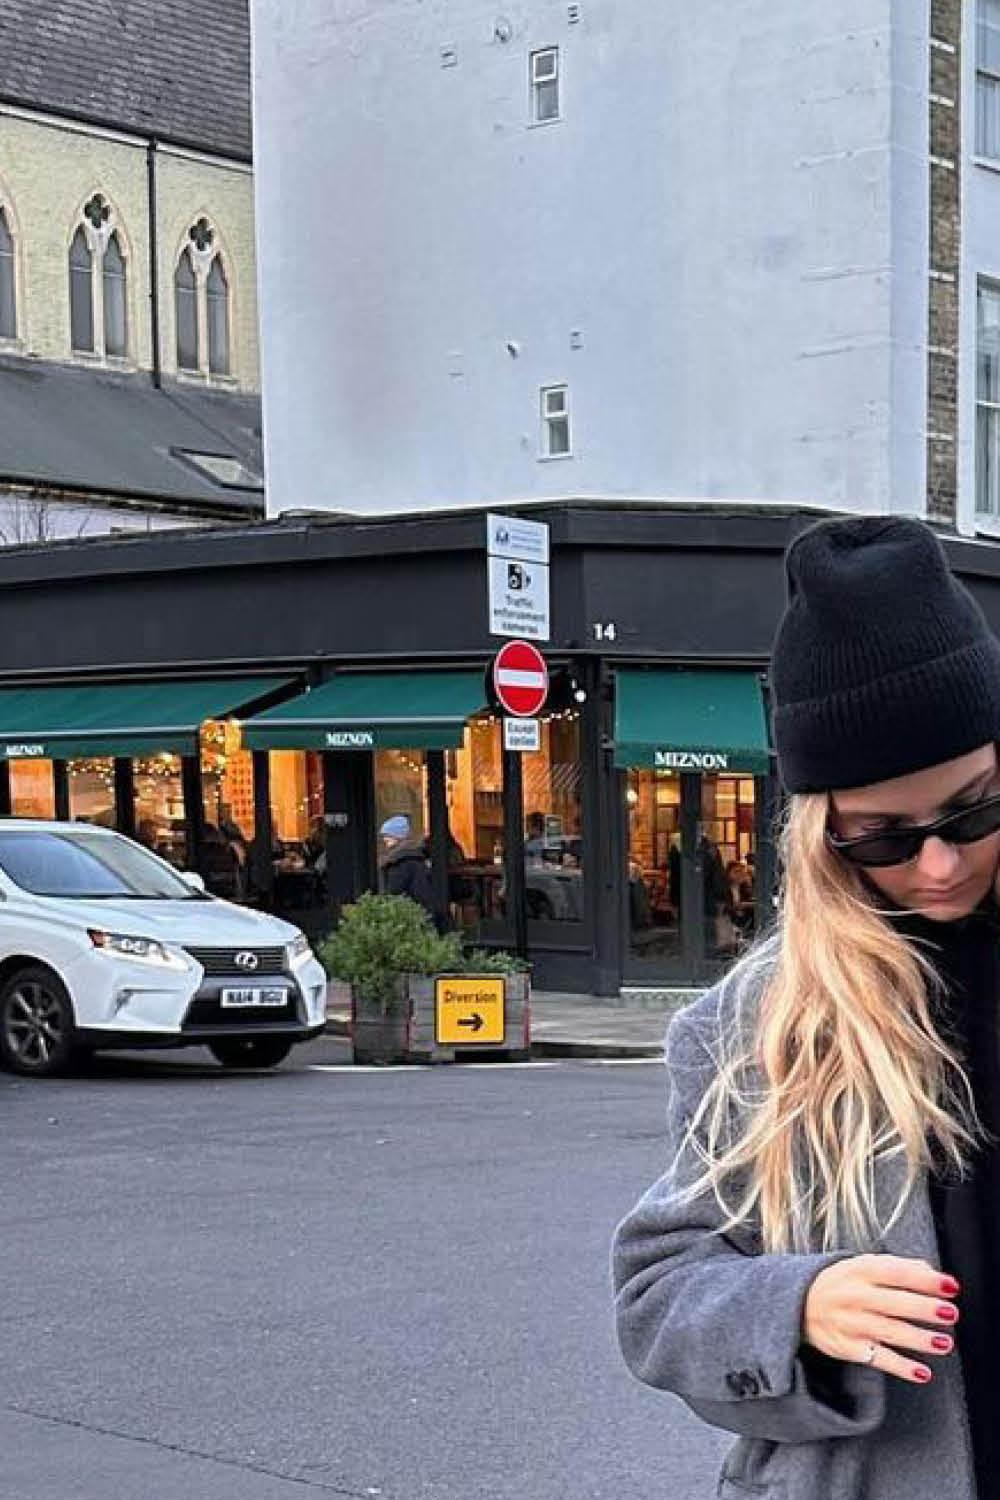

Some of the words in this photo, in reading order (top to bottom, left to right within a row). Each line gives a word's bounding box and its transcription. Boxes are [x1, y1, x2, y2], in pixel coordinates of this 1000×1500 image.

[593, 623, 616, 641] 14
[654, 751, 728, 768] MIZNON
[443, 989, 498, 1005] Diversion
